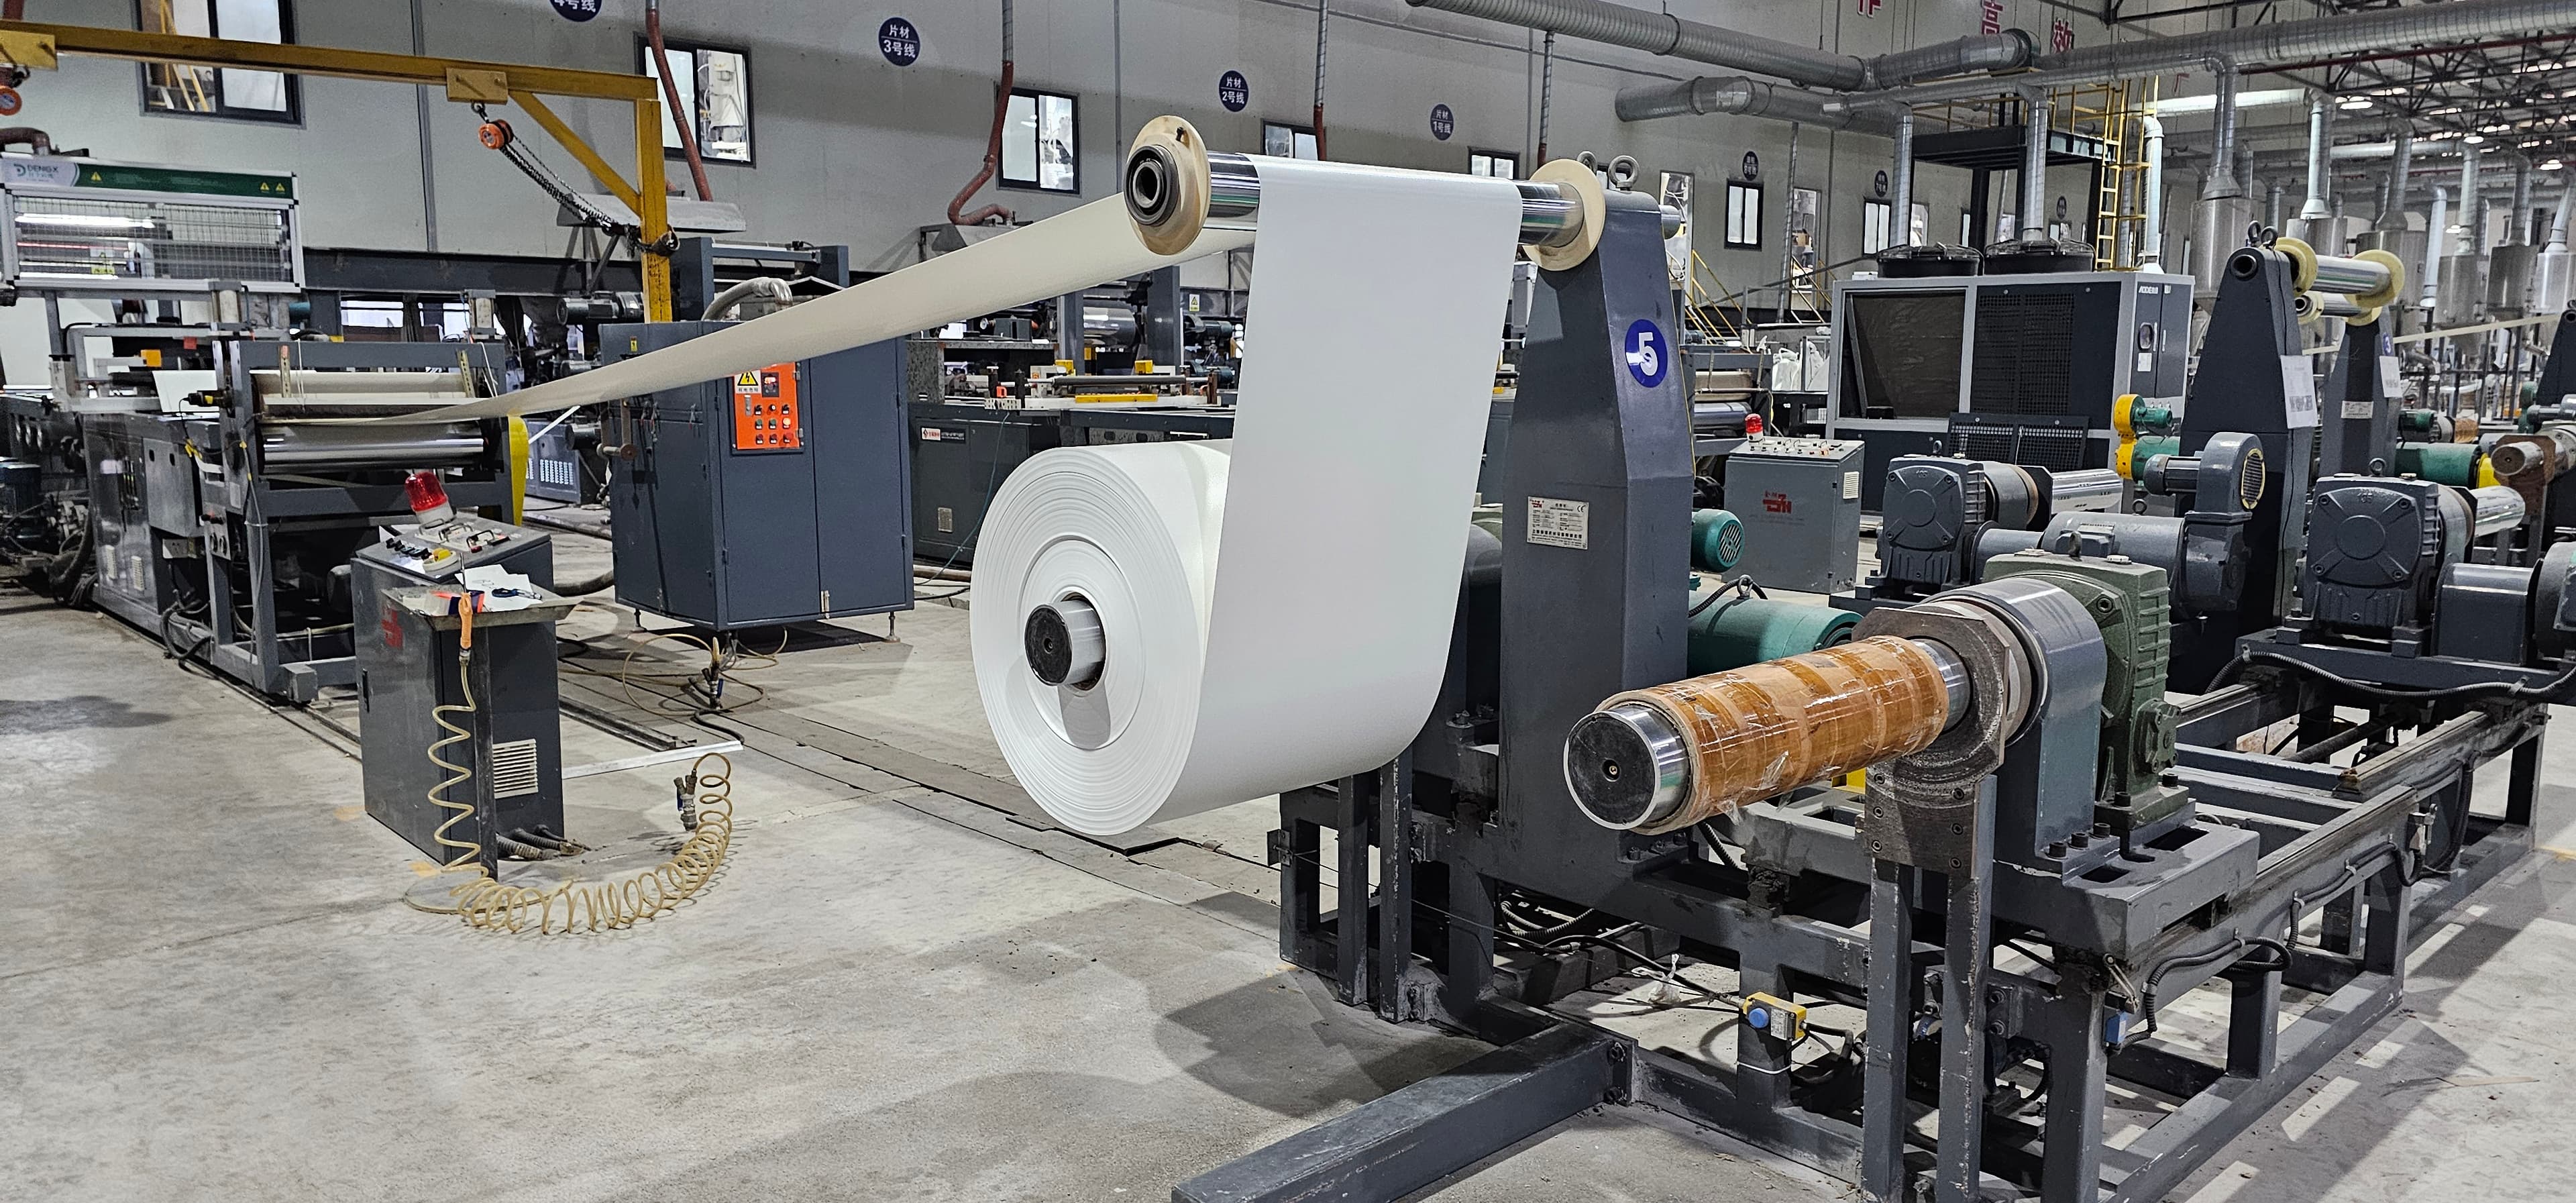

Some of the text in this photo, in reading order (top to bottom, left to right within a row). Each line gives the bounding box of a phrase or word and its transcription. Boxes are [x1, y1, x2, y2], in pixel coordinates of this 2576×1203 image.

[889, 24, 910, 38] 片材
[883, 40, 916, 58] 3号线
[1226, 76, 1241, 88] 片材
[1222, 91, 1244, 104] 2号线
[1436, 109, 1448, 119] 片材
[1433, 121, 1451, 134] 1号线
[1639, 332, 1658, 376] 5
